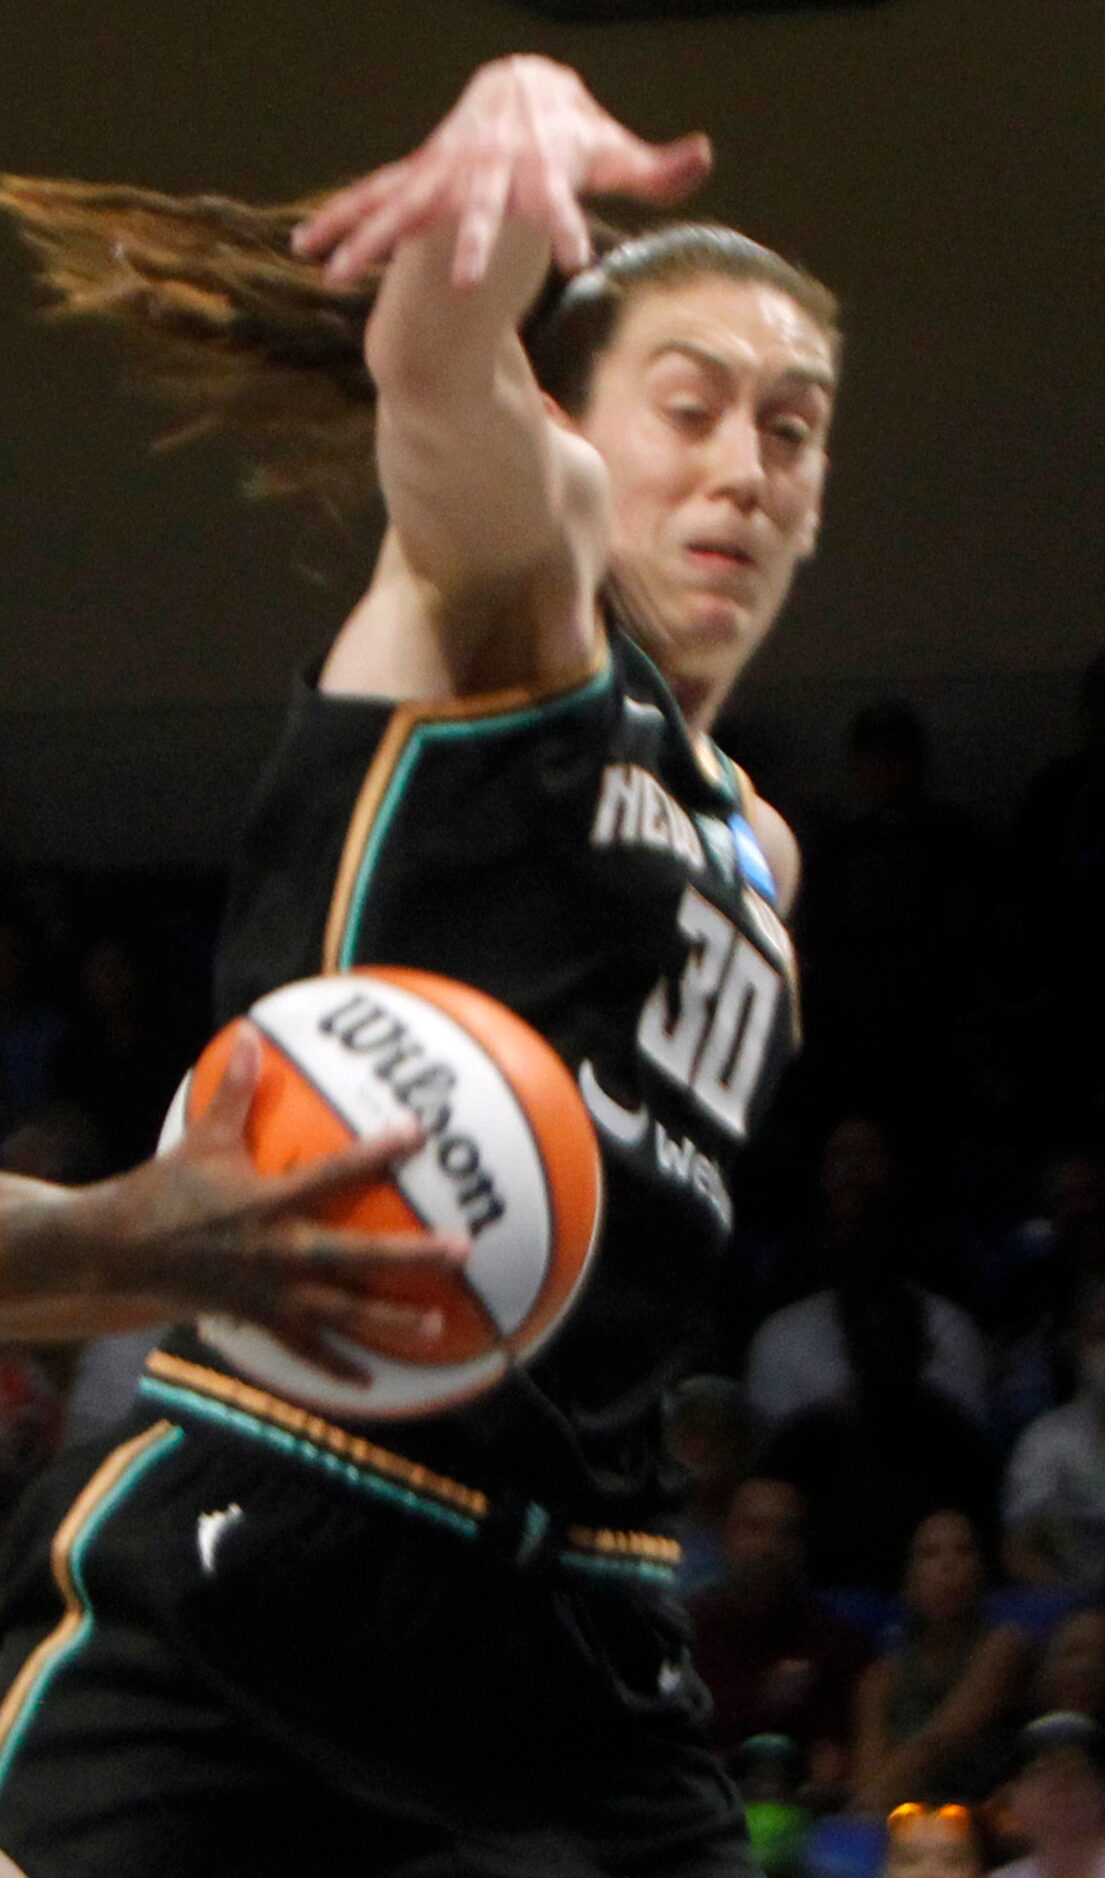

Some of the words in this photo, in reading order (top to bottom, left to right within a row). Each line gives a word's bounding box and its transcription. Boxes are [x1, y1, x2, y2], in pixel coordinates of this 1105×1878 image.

[588, 762, 707, 872] NEW
[317, 994, 506, 1237] Wilson
[636, 882, 784, 1140] 30
